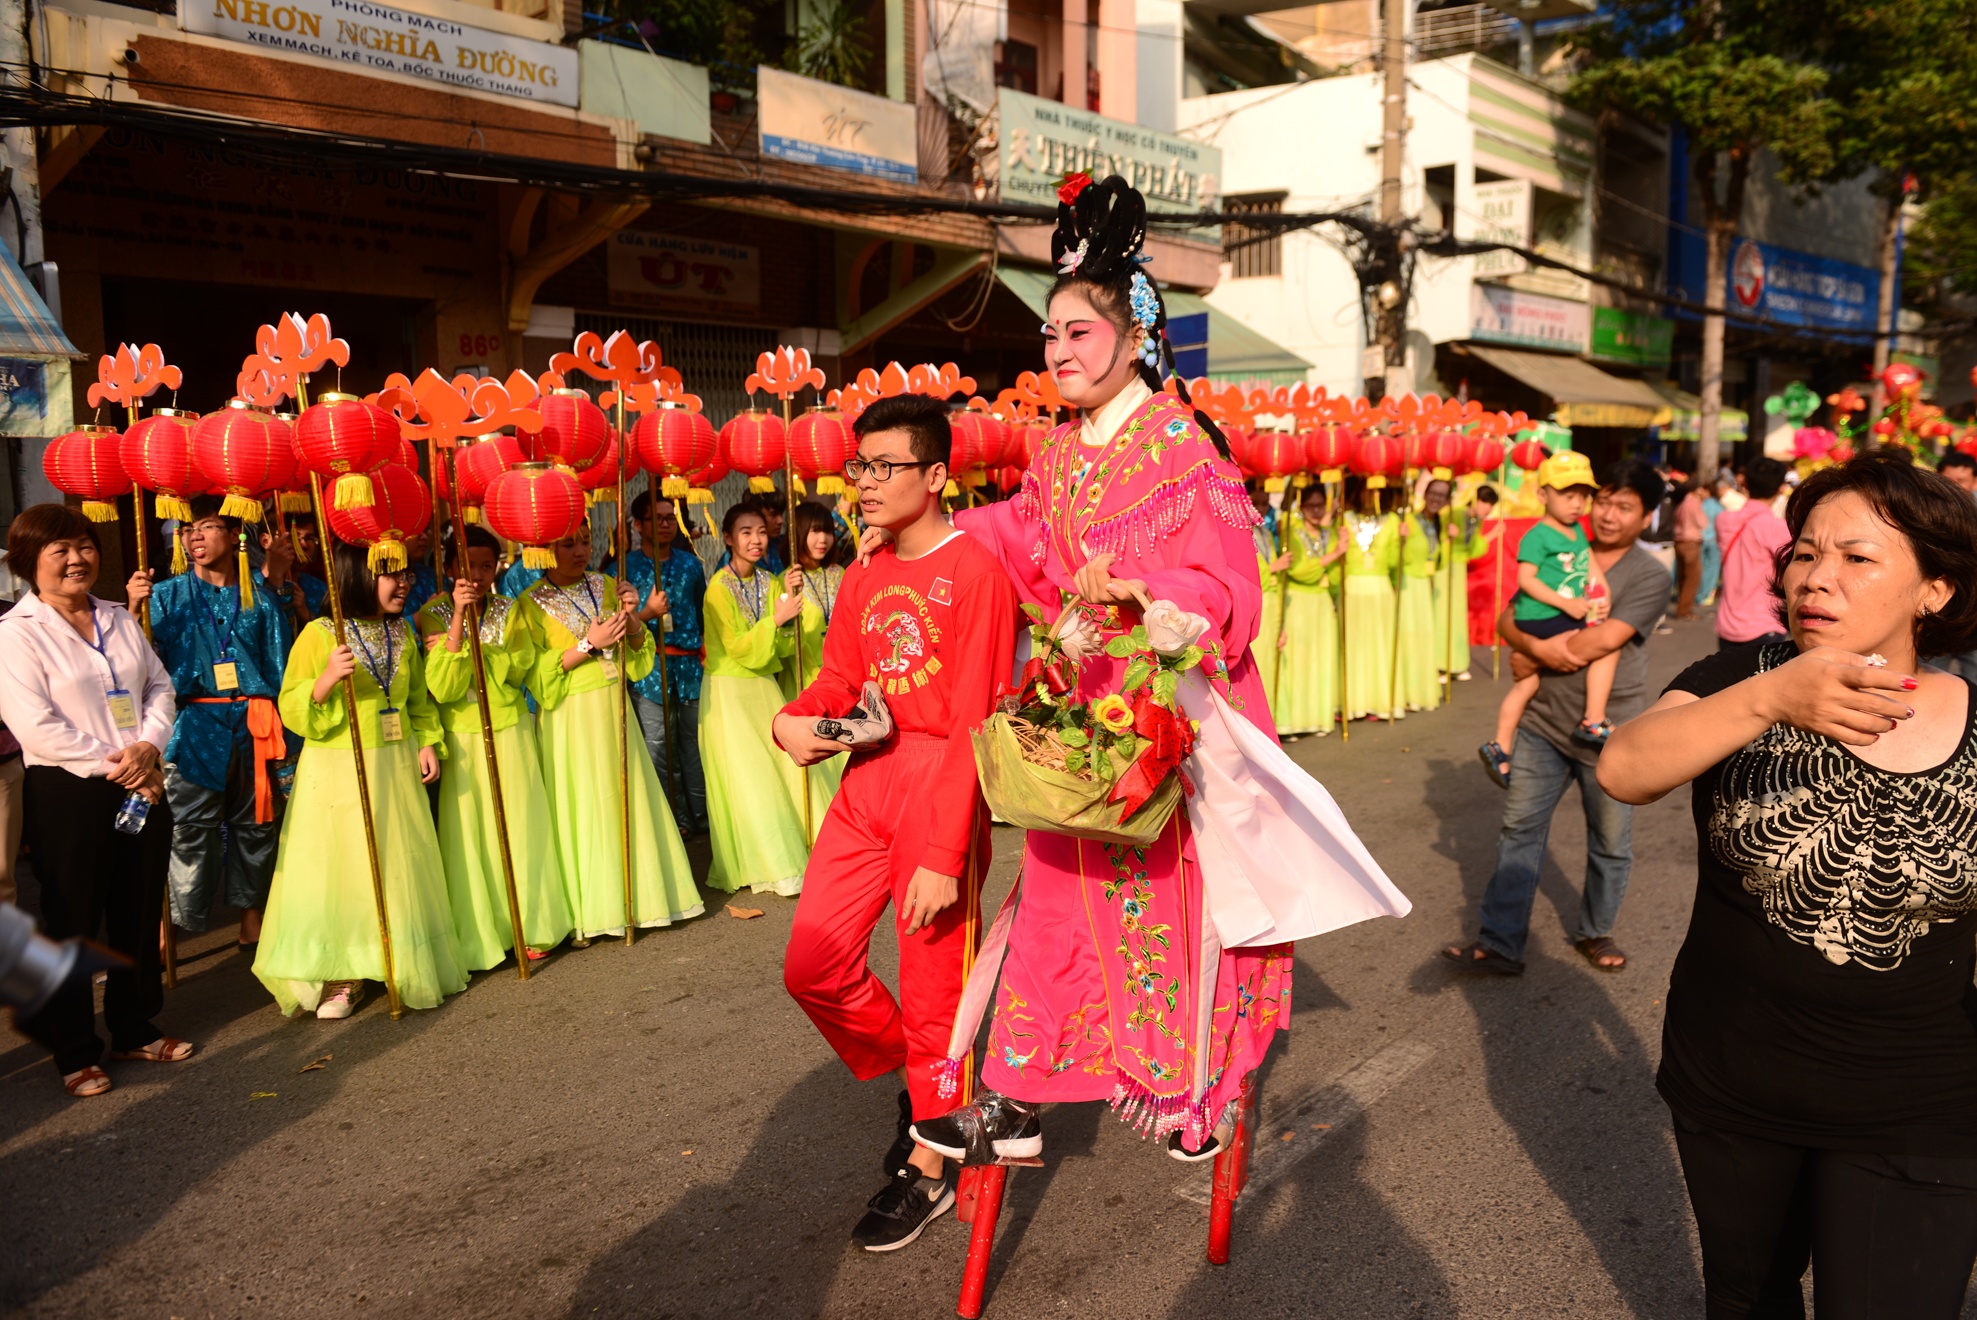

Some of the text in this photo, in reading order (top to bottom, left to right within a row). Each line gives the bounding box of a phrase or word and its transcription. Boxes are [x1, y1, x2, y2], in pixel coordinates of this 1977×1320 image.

[330, 0, 462, 37] PHÒNG MẠCH
[213, 0, 558, 87] NHƠN NGHĨA ĐƯỜNG
[403, 61, 433, 77] BỐC
[438, 69, 484, 87] THUỐC
[489, 79, 533, 97] THANG
[649, 235, 687, 251] HÀNG
[870, 590, 883, 608] KIM
[884, 585, 906, 597] LONG
[923, 616, 942, 643] KIẾN
